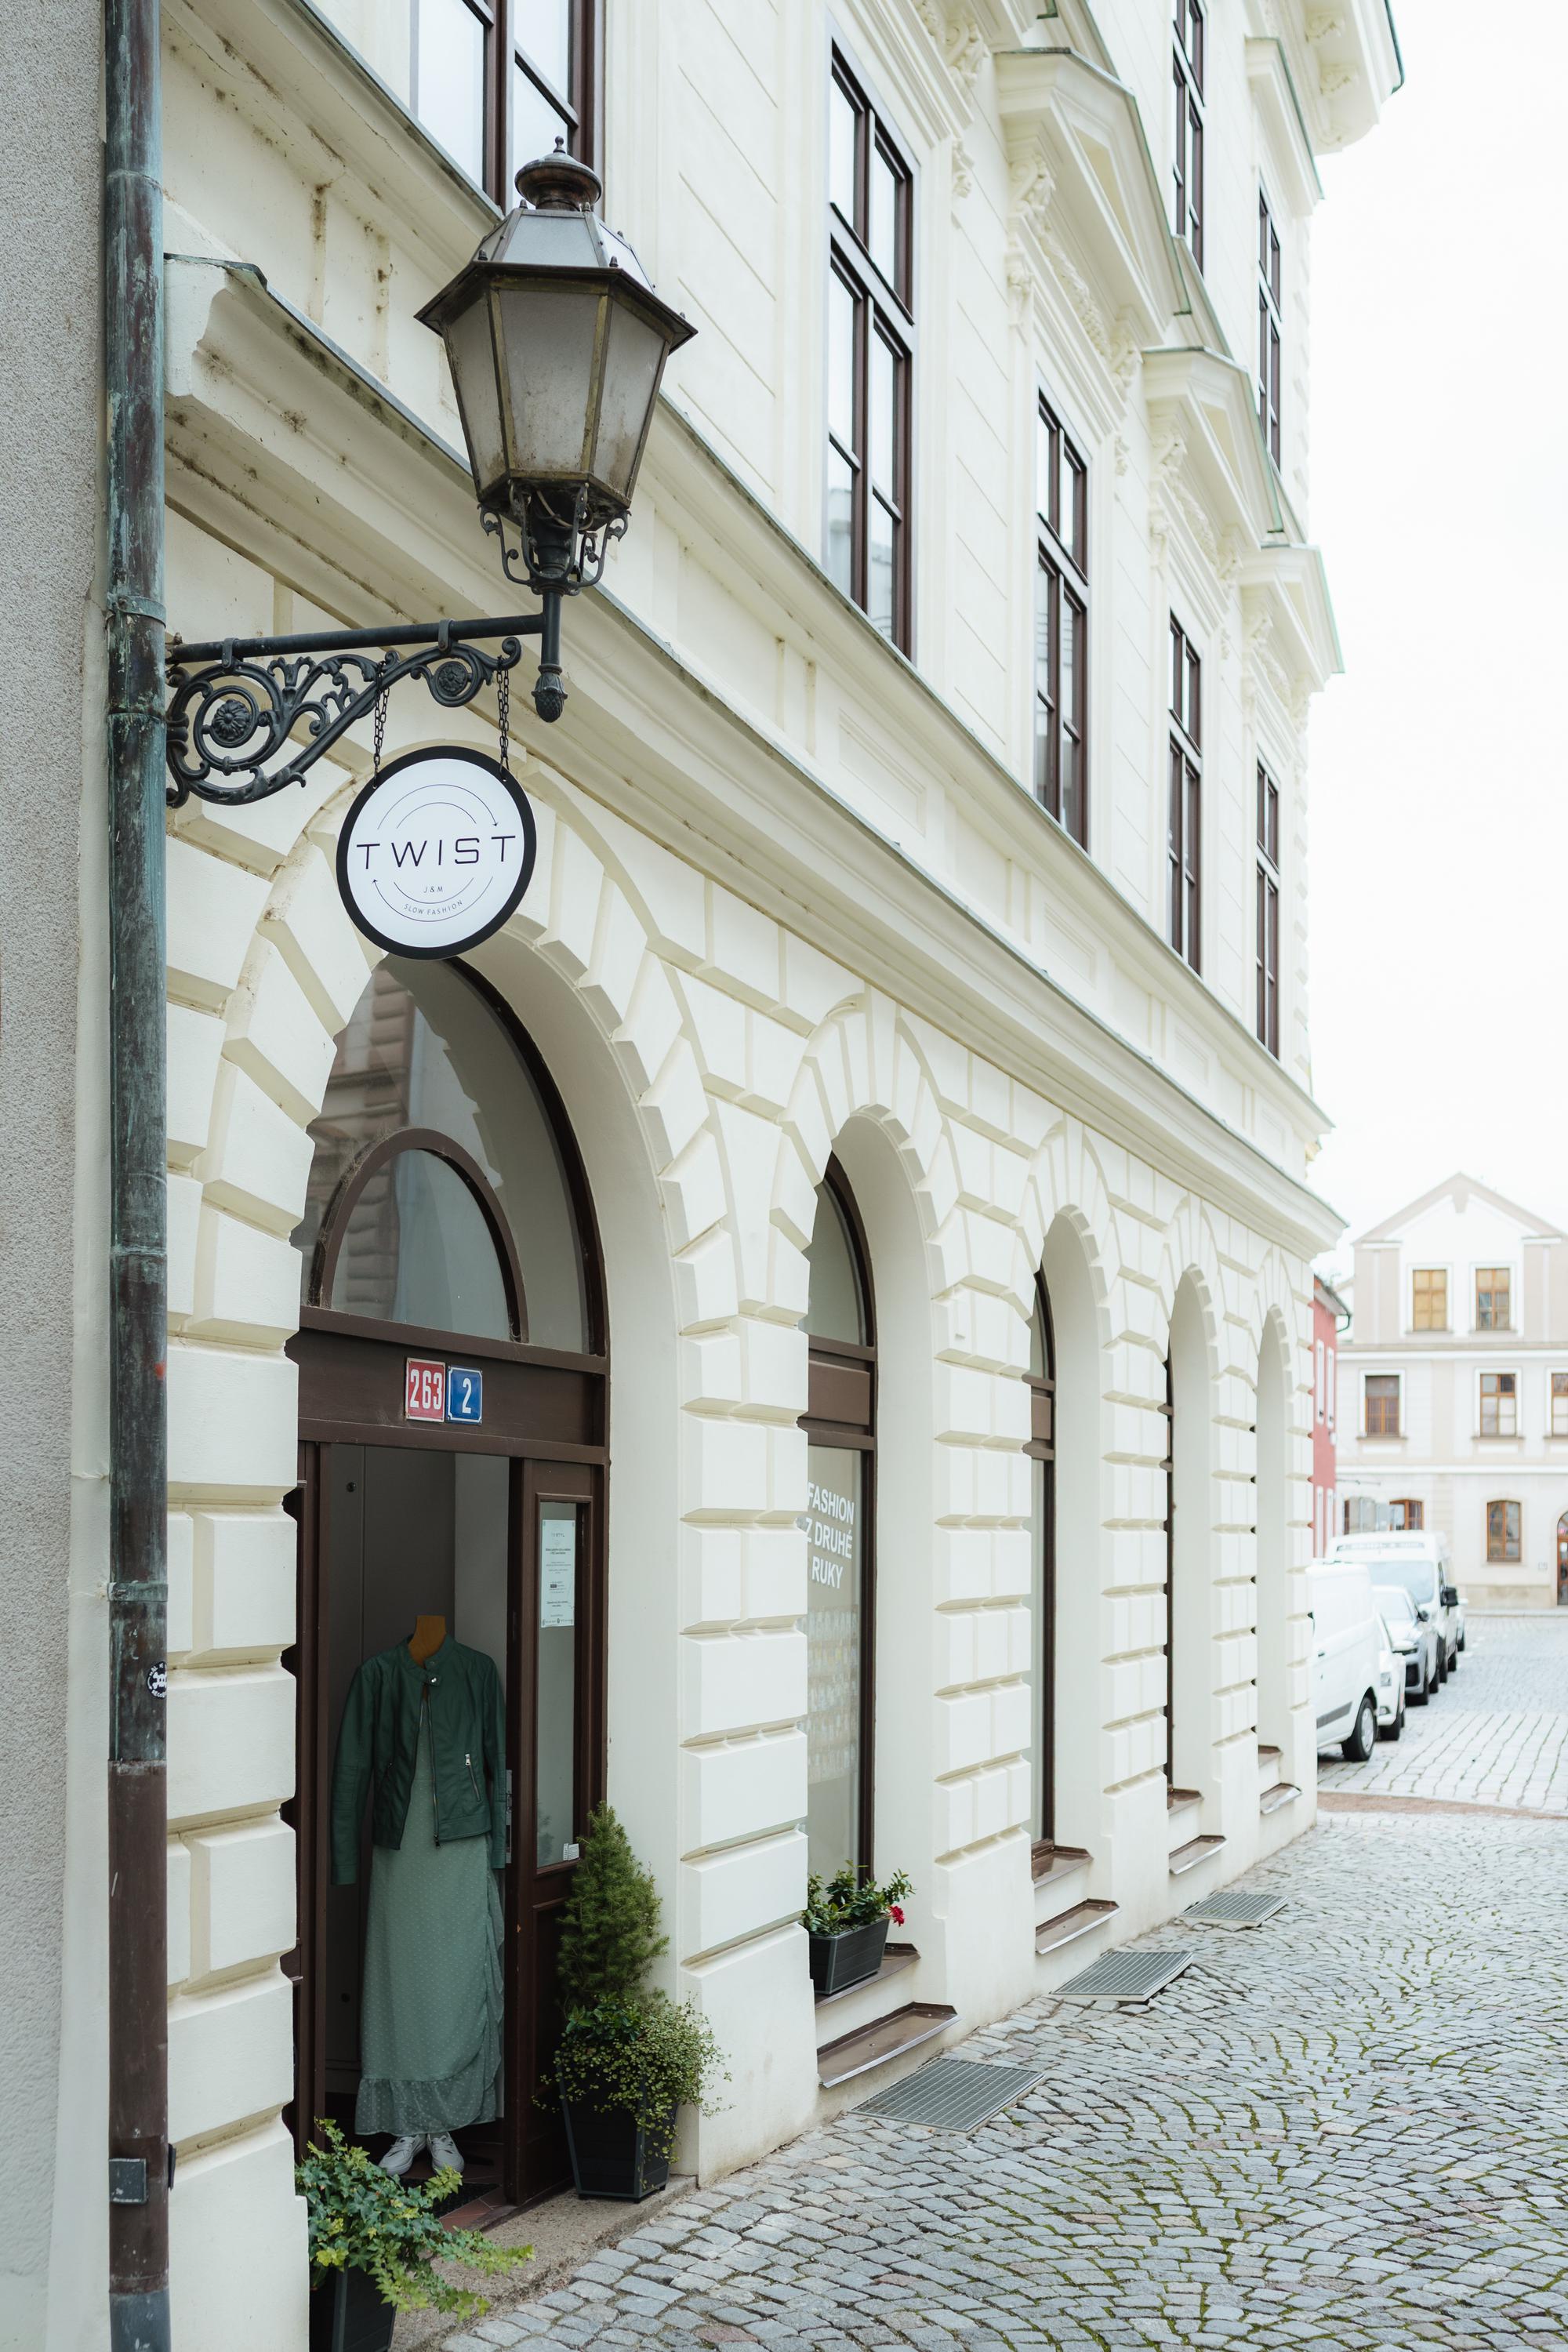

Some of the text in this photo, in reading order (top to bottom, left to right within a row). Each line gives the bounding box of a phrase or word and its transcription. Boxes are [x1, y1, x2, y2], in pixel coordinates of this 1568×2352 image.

[356, 835, 516, 869] TWIST
[403, 899, 463, 916] SLOW FASHION
[409, 1368, 443, 1410] 263
[462, 1377, 472, 1414] 2
[808, 1482, 854, 1524] FASHION
[815, 1521, 853, 1559] DRUHÉ
[811, 1555, 844, 1589] RUKY
